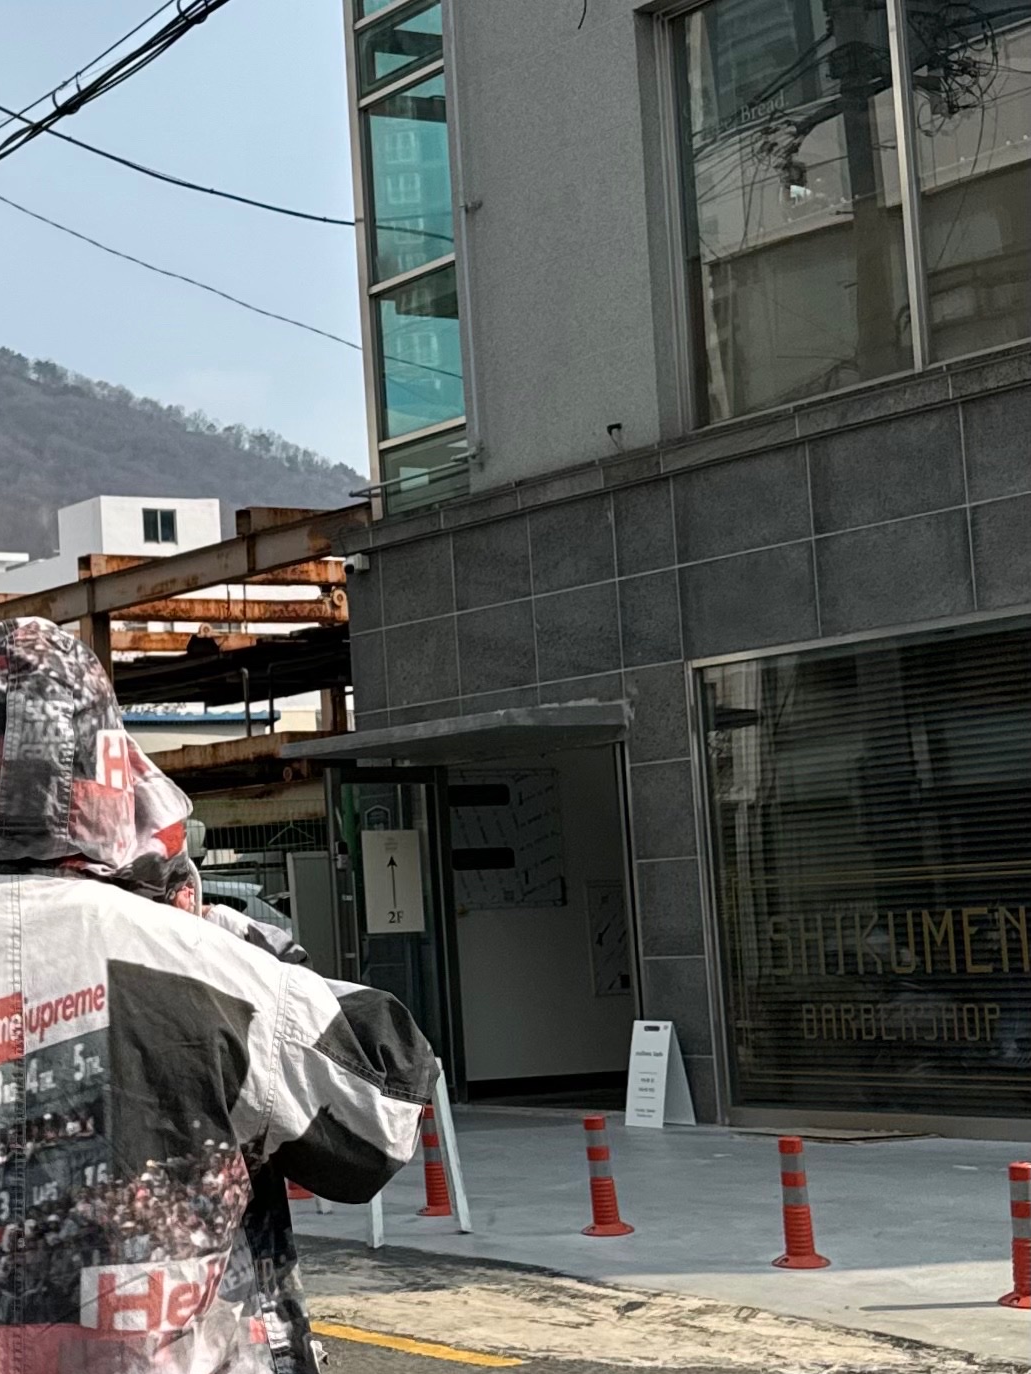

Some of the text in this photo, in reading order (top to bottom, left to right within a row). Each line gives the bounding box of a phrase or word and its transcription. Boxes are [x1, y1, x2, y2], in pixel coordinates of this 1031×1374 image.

[740, 88, 790, 122] Bread.
[388, 910, 404, 924] 2F
[768, 905, 1031, 978] SHIKUMEN
[802, 1003, 1001, 1042] BARBERSHOP
